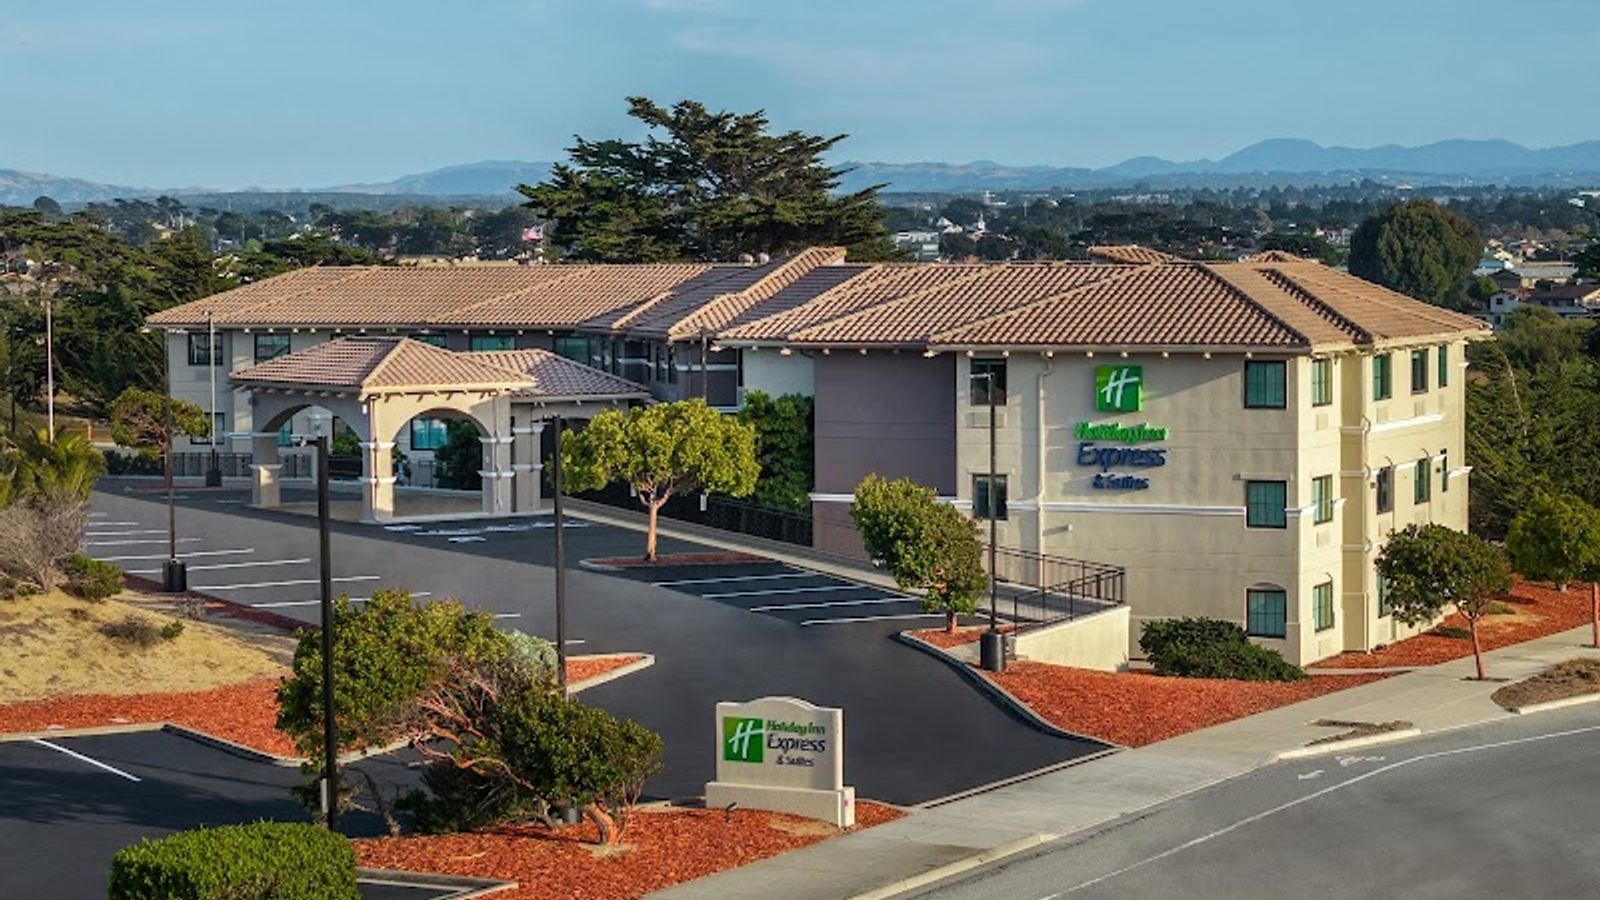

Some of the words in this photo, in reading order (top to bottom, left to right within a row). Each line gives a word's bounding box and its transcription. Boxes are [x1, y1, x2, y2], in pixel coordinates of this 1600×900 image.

[1075, 422, 1136, 444] Holiday
[1078, 442, 1167, 472] Express
[766, 720, 807, 735] Holiday
[808, 721, 825, 734] Inn
[767, 733, 826, 754] Express
[785, 756, 815, 767] Suites
